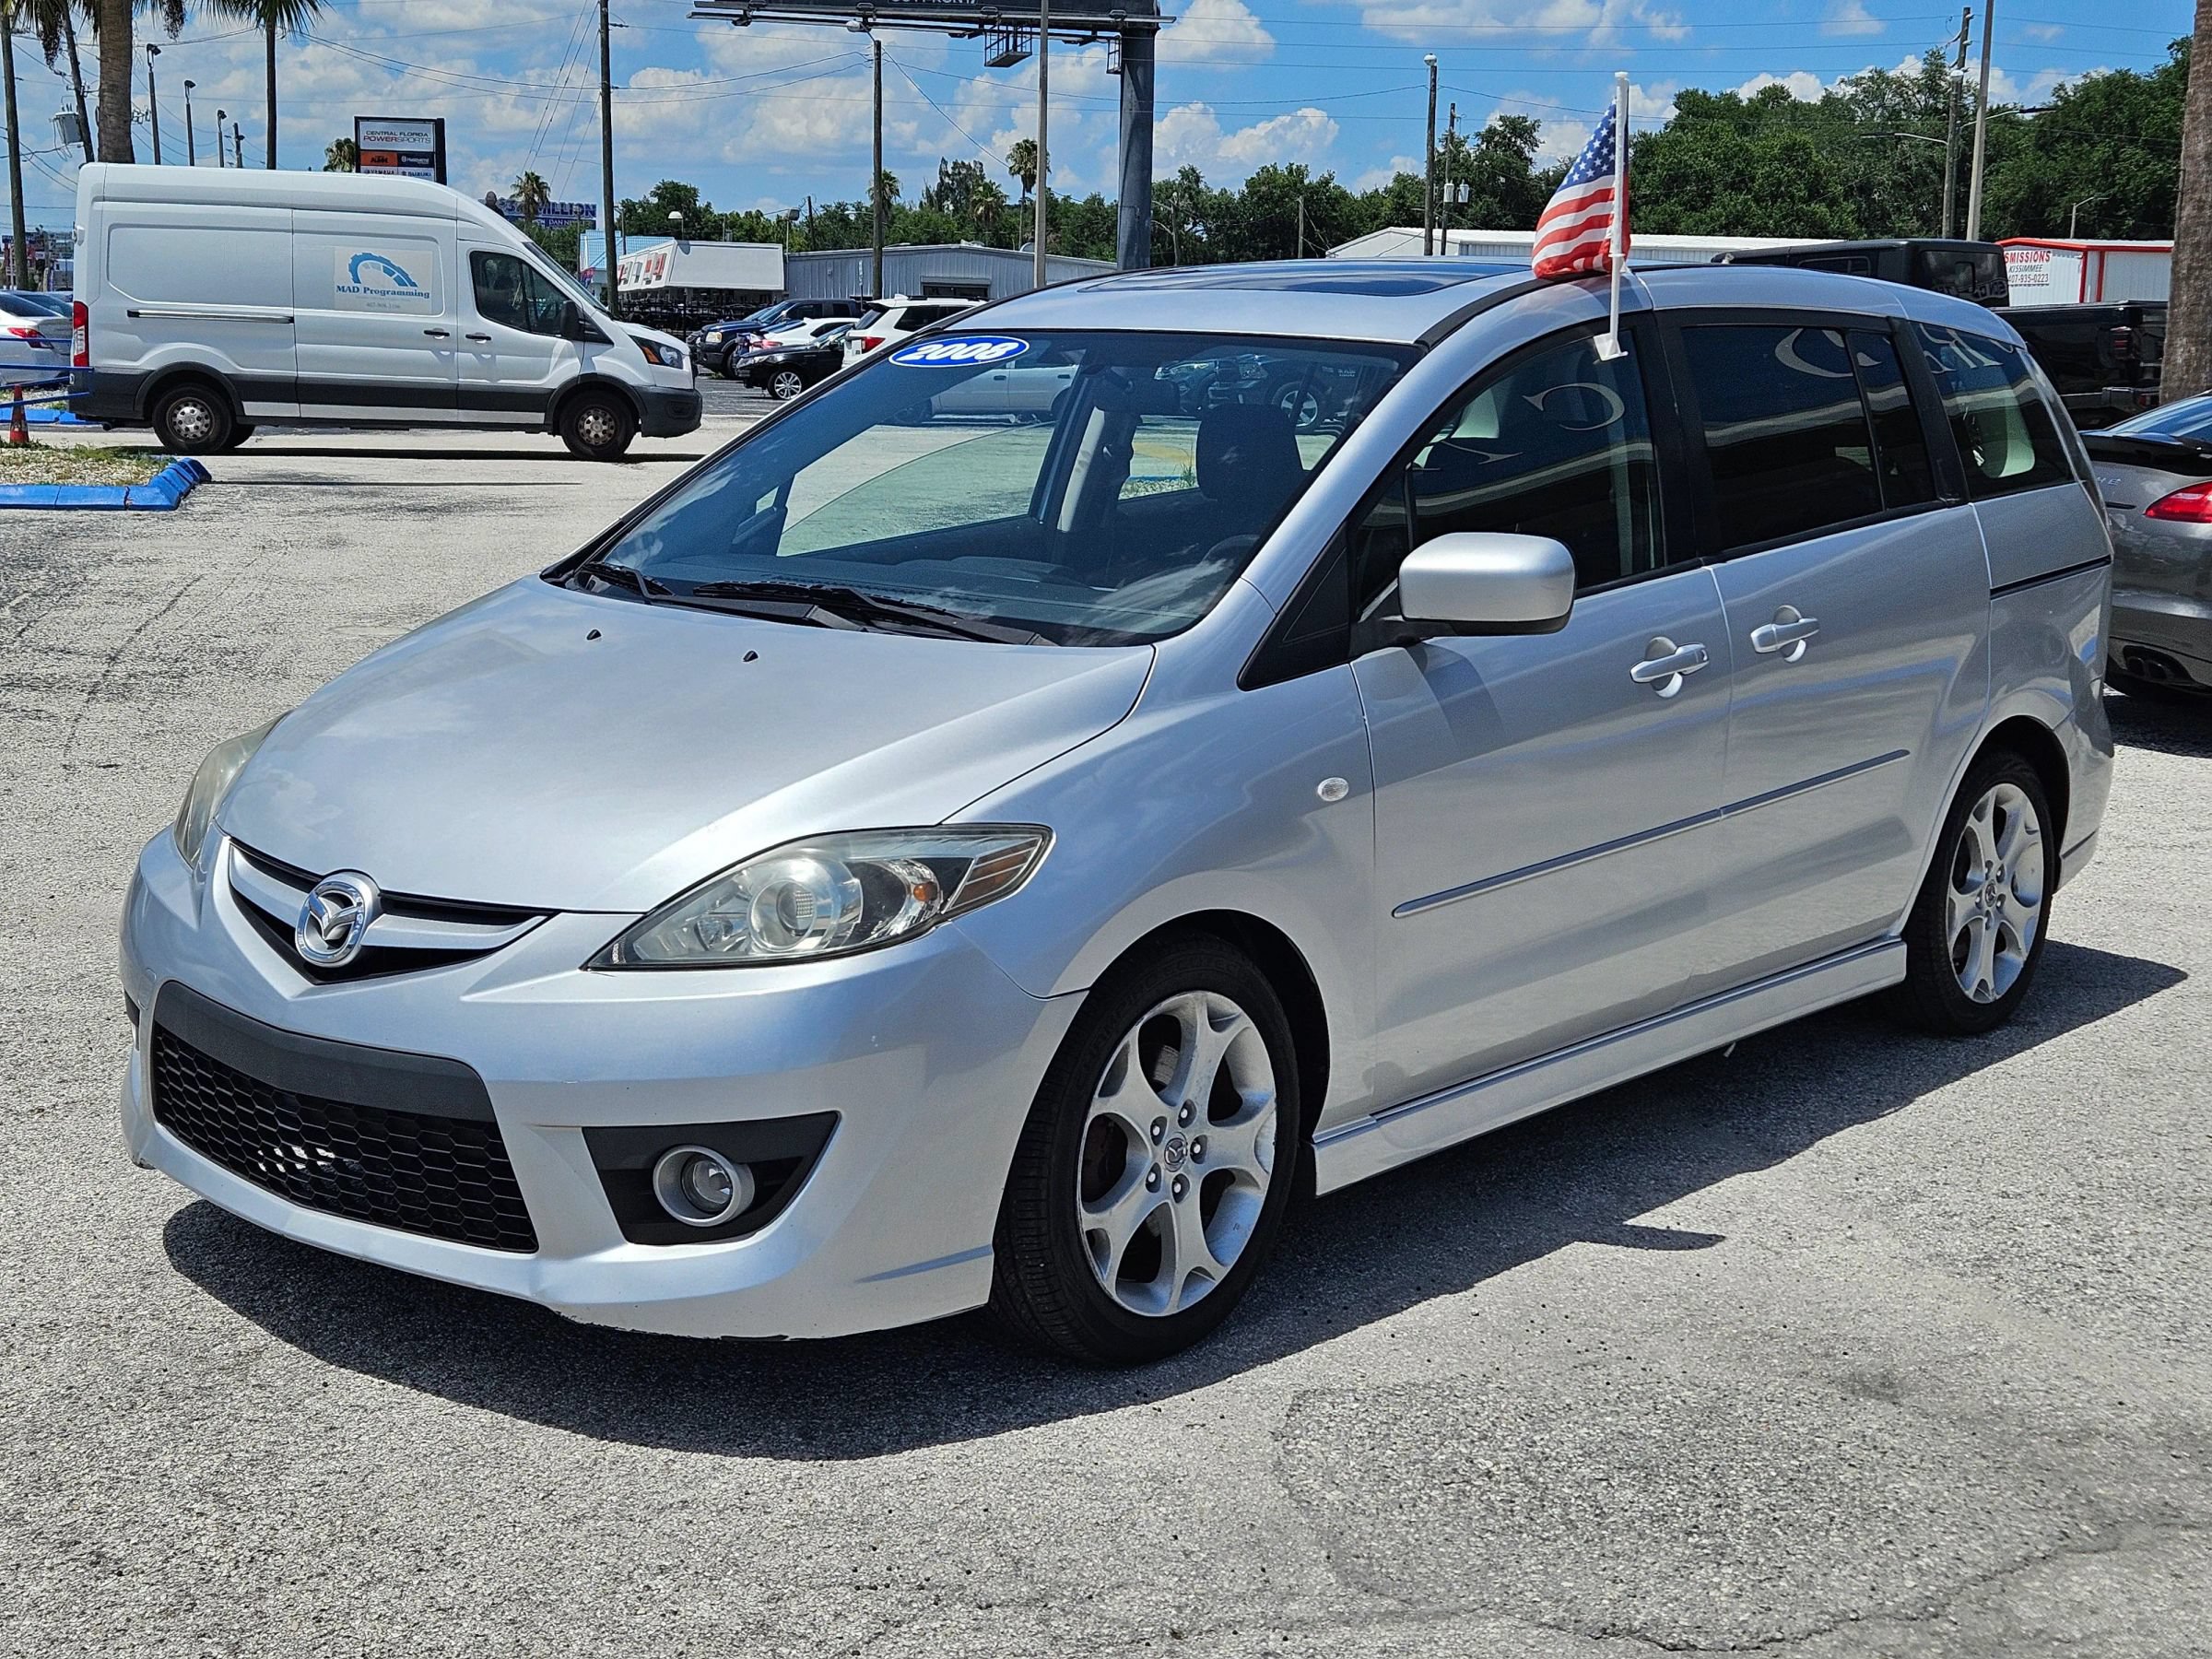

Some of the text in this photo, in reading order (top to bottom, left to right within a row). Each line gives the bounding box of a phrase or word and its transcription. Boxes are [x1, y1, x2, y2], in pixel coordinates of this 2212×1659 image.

[363, 135, 431, 144] POWERSPORTS
[2008, 265, 2043, 273] KISSIMMEE
[336, 285, 430, 299] MAD Programming
[895, 342, 1019, 361] 2008
